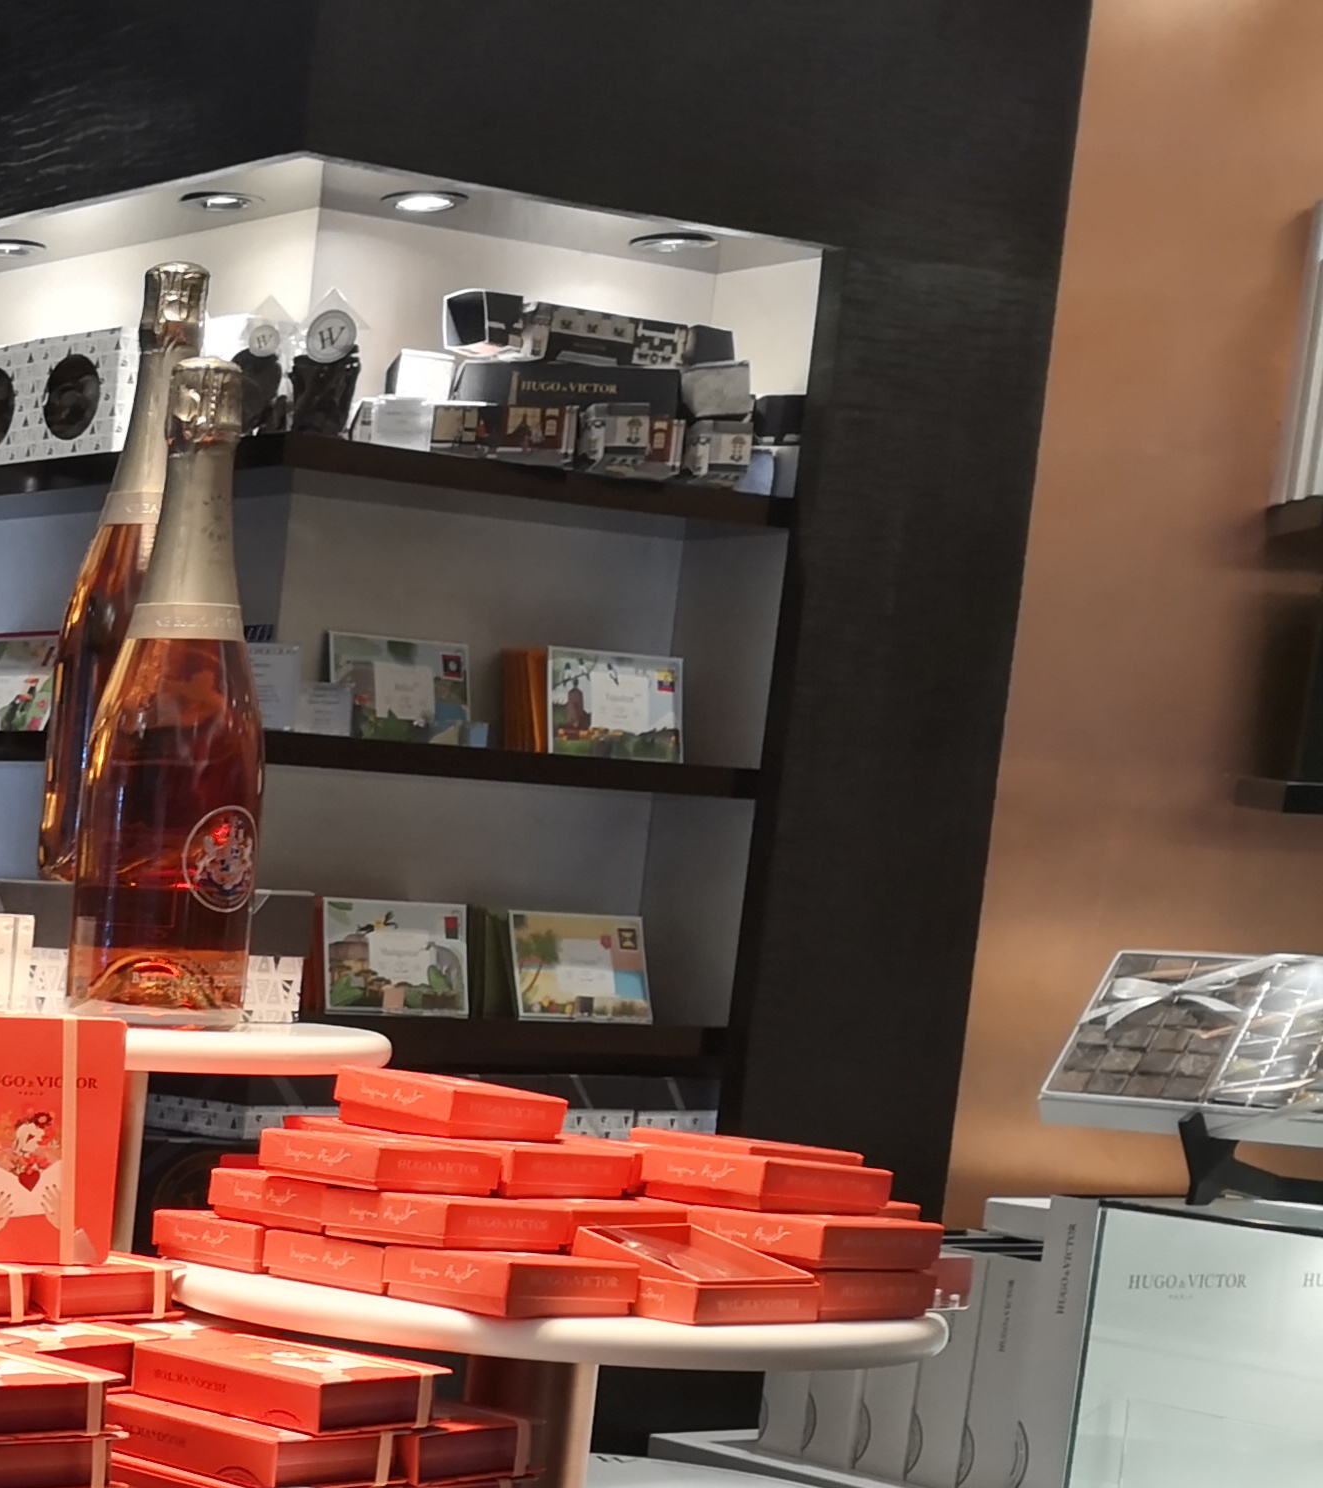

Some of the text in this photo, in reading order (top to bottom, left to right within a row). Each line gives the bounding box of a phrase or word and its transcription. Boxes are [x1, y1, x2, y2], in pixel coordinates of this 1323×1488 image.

[36, 1076, 98, 1090] VICOR
[1127, 1273, 1178, 1289] HUGO
[1187, 1273, 1248, 1289] VICTOR
